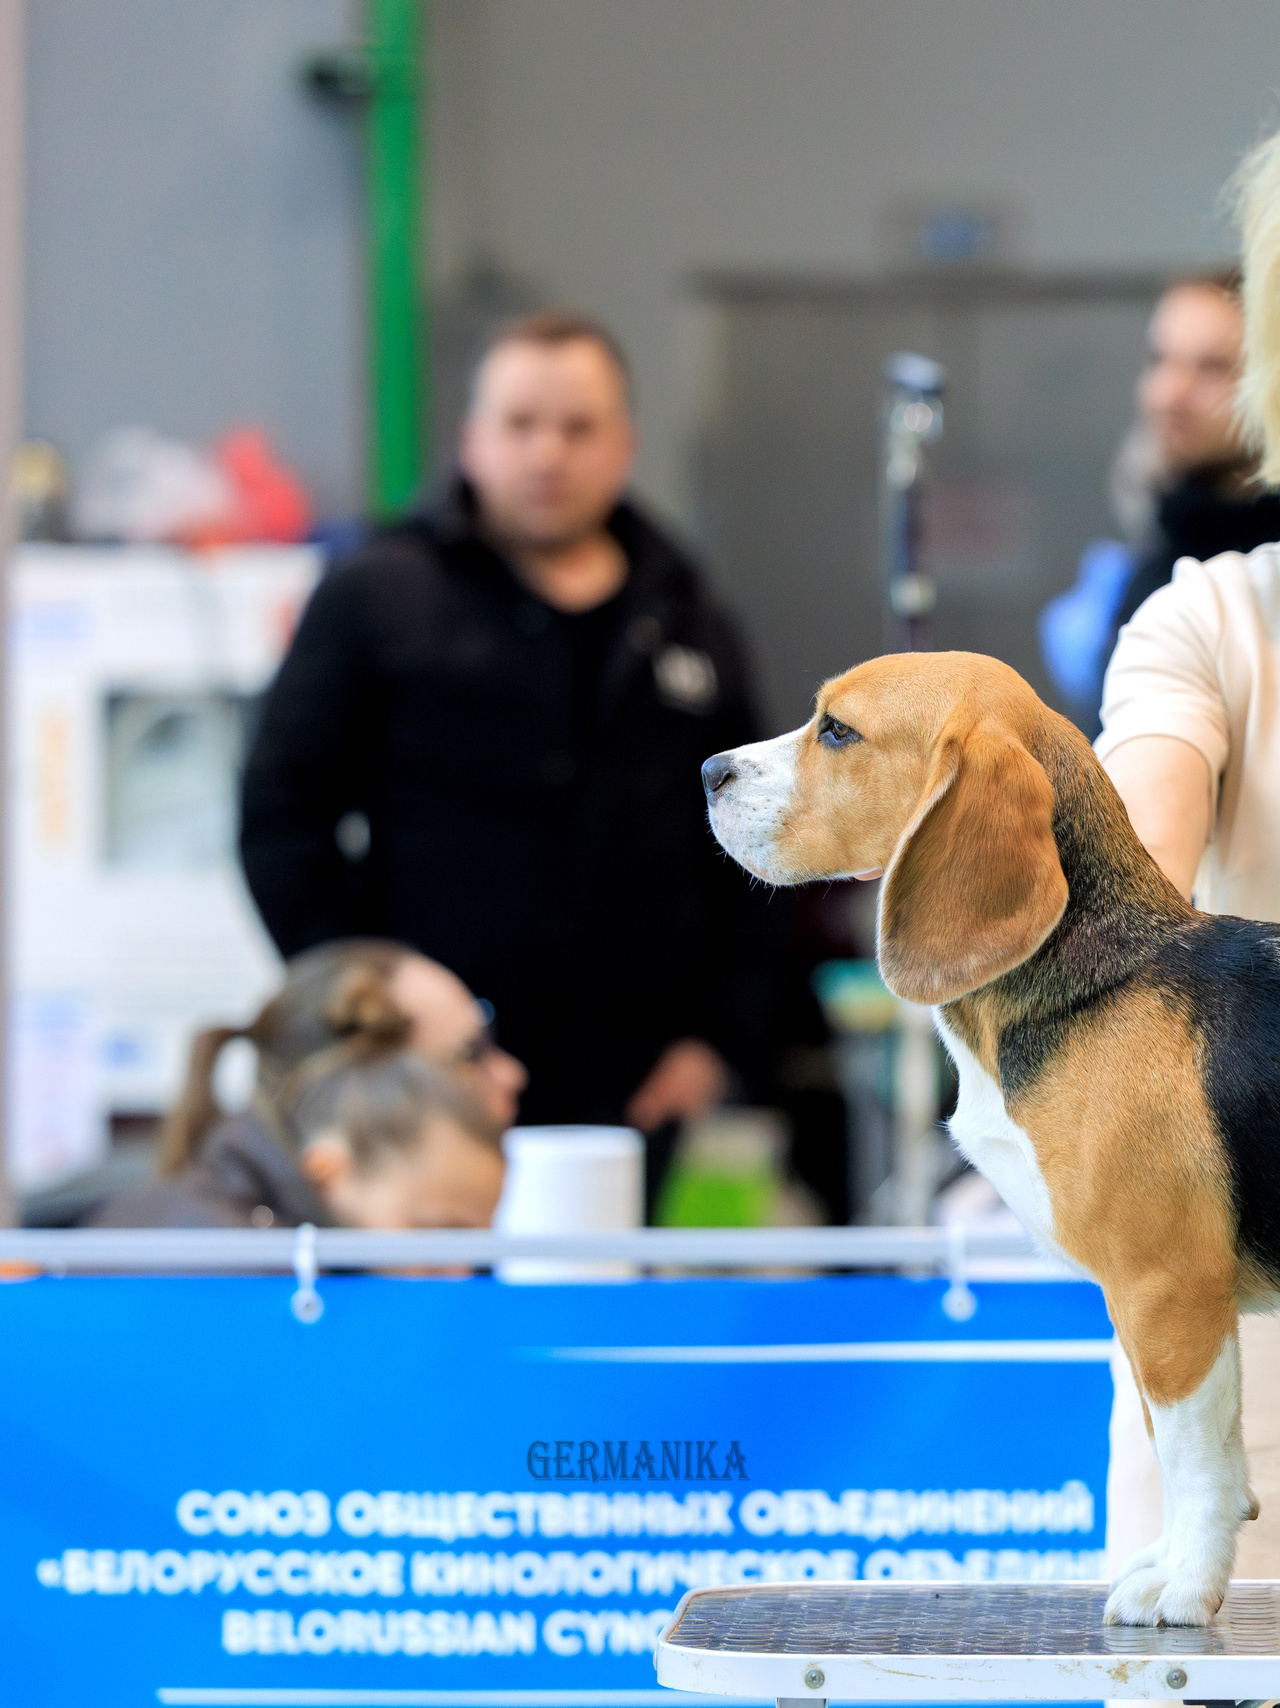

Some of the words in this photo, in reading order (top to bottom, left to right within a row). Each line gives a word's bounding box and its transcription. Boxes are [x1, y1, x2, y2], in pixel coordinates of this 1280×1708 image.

[177, 1490, 331, 1537] СОЮЗ
[336, 1490, 734, 1542] ОБЩЕСТВЕННЫХ
[739, 1480, 1094, 1541] ОБЪЕДИНЕНИЙ
[410, 1549, 859, 1597] КИНОЛОГИЧЕСКОЕ
[222, 1609, 536, 1656] BELORUSSIAN
